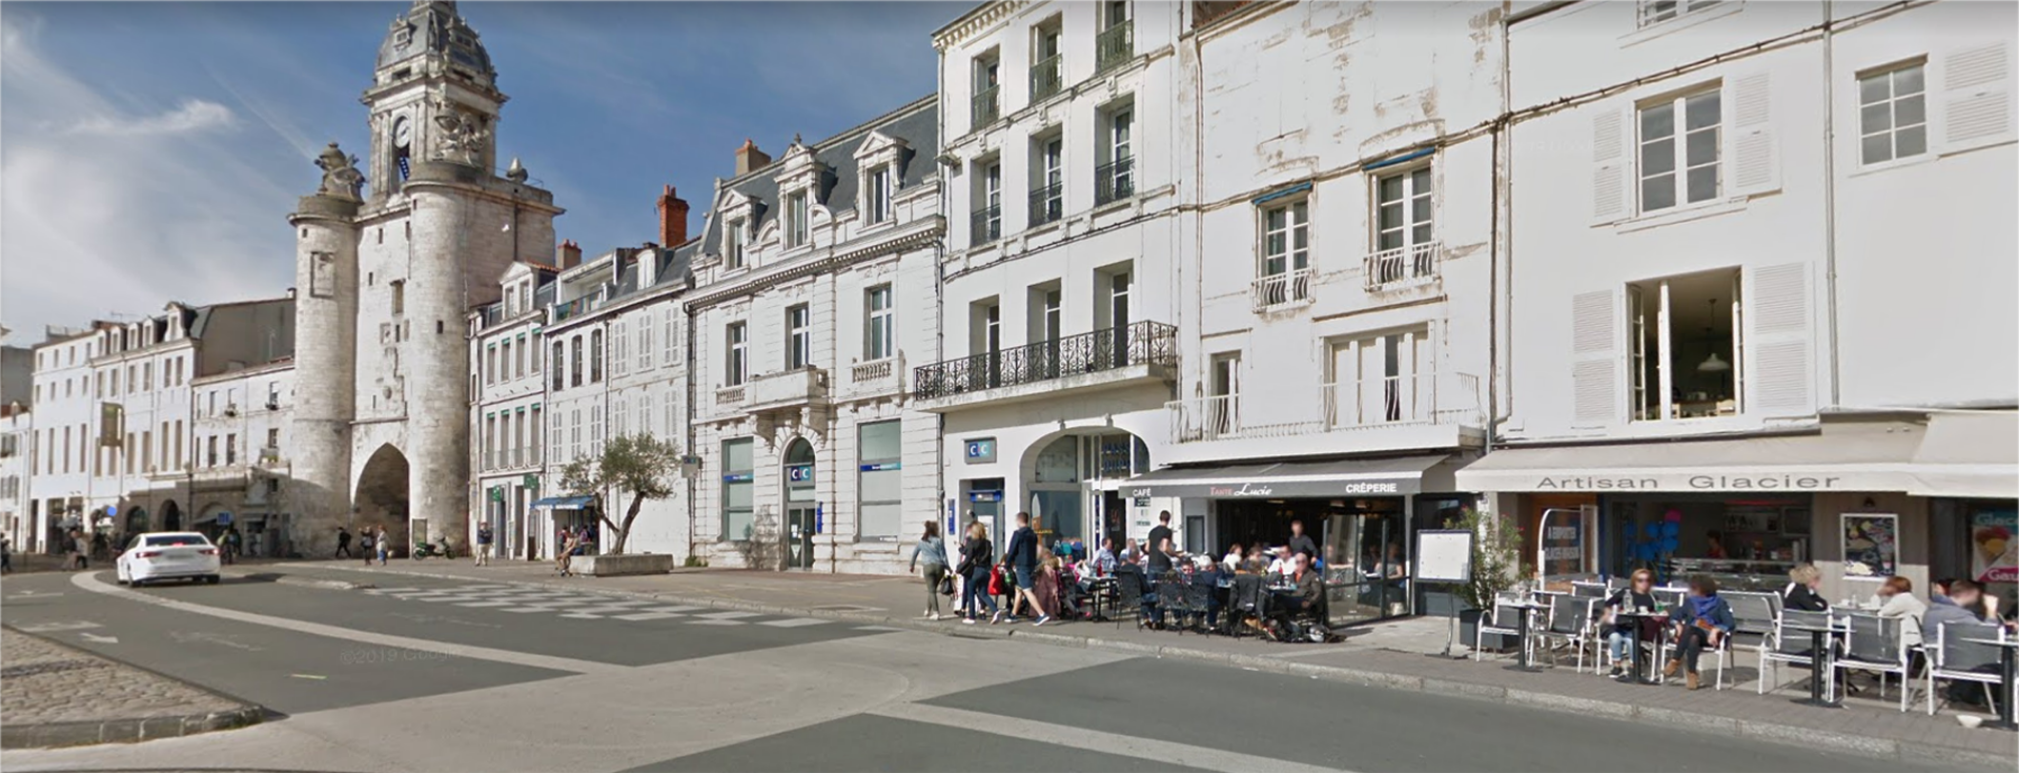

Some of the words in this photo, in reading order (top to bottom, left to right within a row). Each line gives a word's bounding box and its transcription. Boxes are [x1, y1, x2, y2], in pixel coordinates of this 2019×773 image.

[1345, 481, 1397, 494] CRÊPERIE
[1536, 476, 1658, 489] Artisan
[1688, 474, 1840, 489] Glacier
[1132, 487, 1151, 497] CAFÉ
[1233, 482, 1273, 497] Lucie
